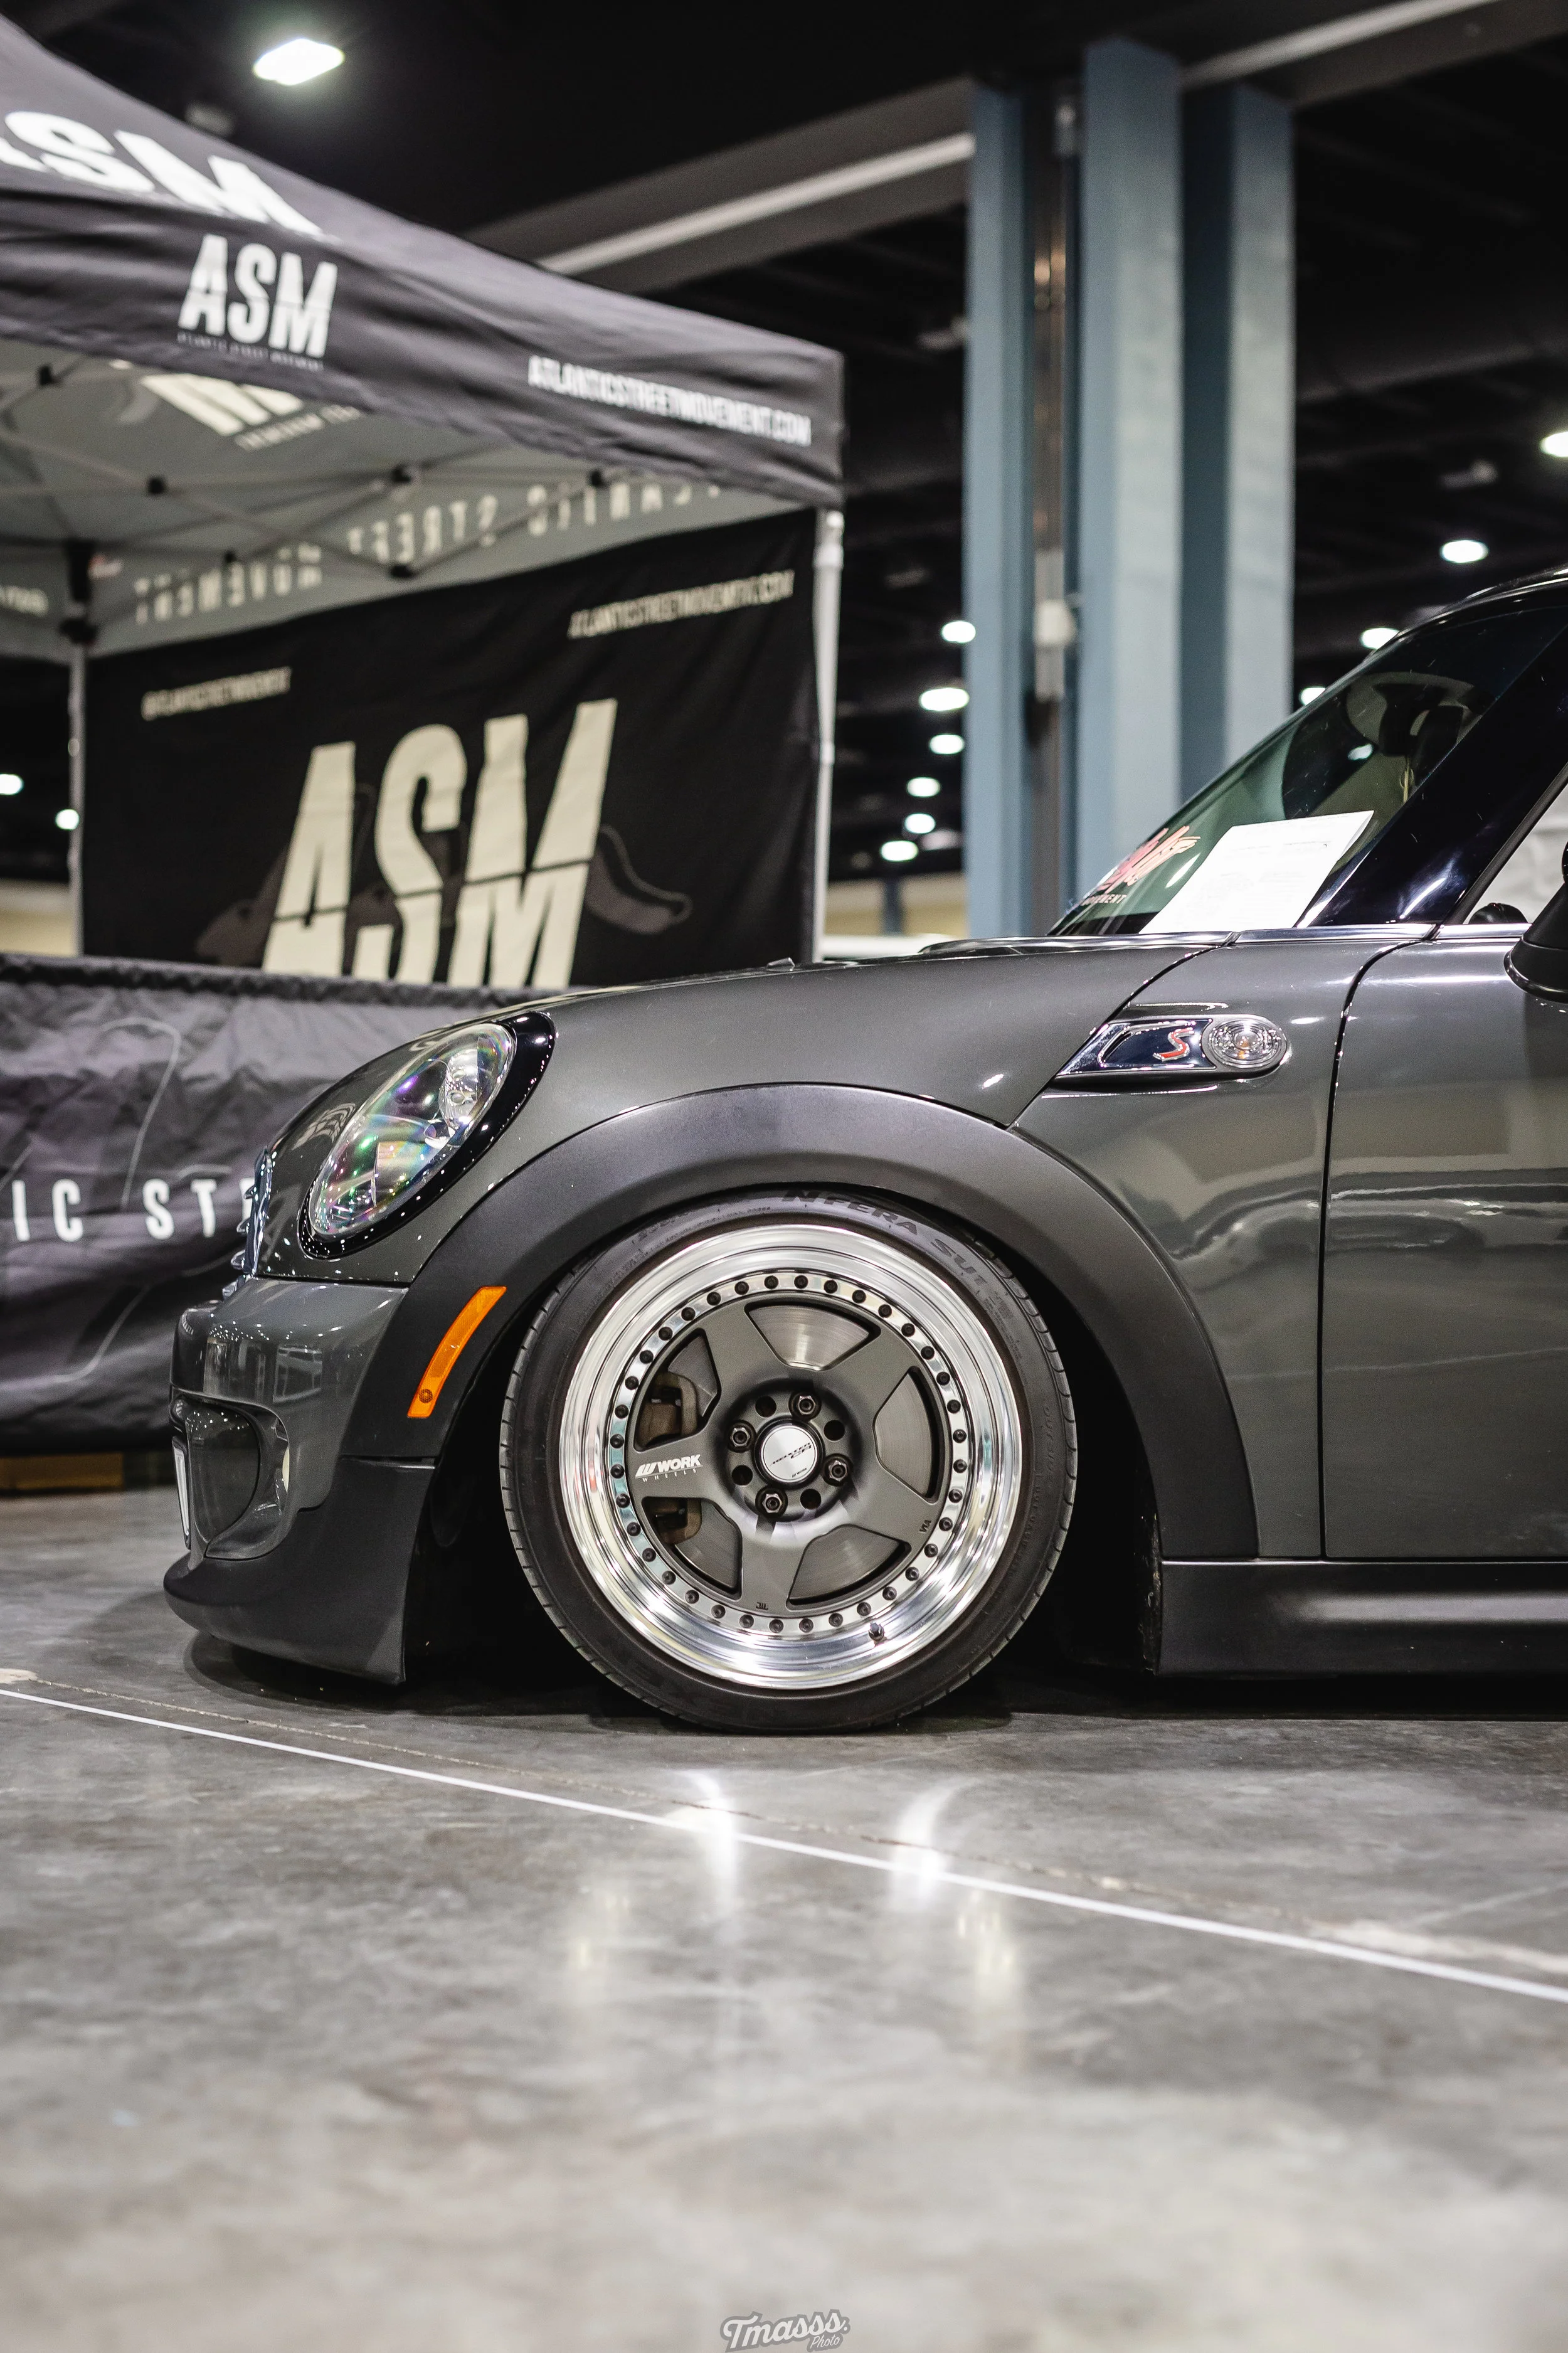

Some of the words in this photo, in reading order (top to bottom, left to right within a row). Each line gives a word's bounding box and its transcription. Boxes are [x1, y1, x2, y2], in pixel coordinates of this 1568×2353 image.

[178, 234, 337, 358] ASM
[262, 698, 618, 989] ASM
[1153, 1027, 1195, 1061] S
[657, 1454, 701, 1473] WORK
